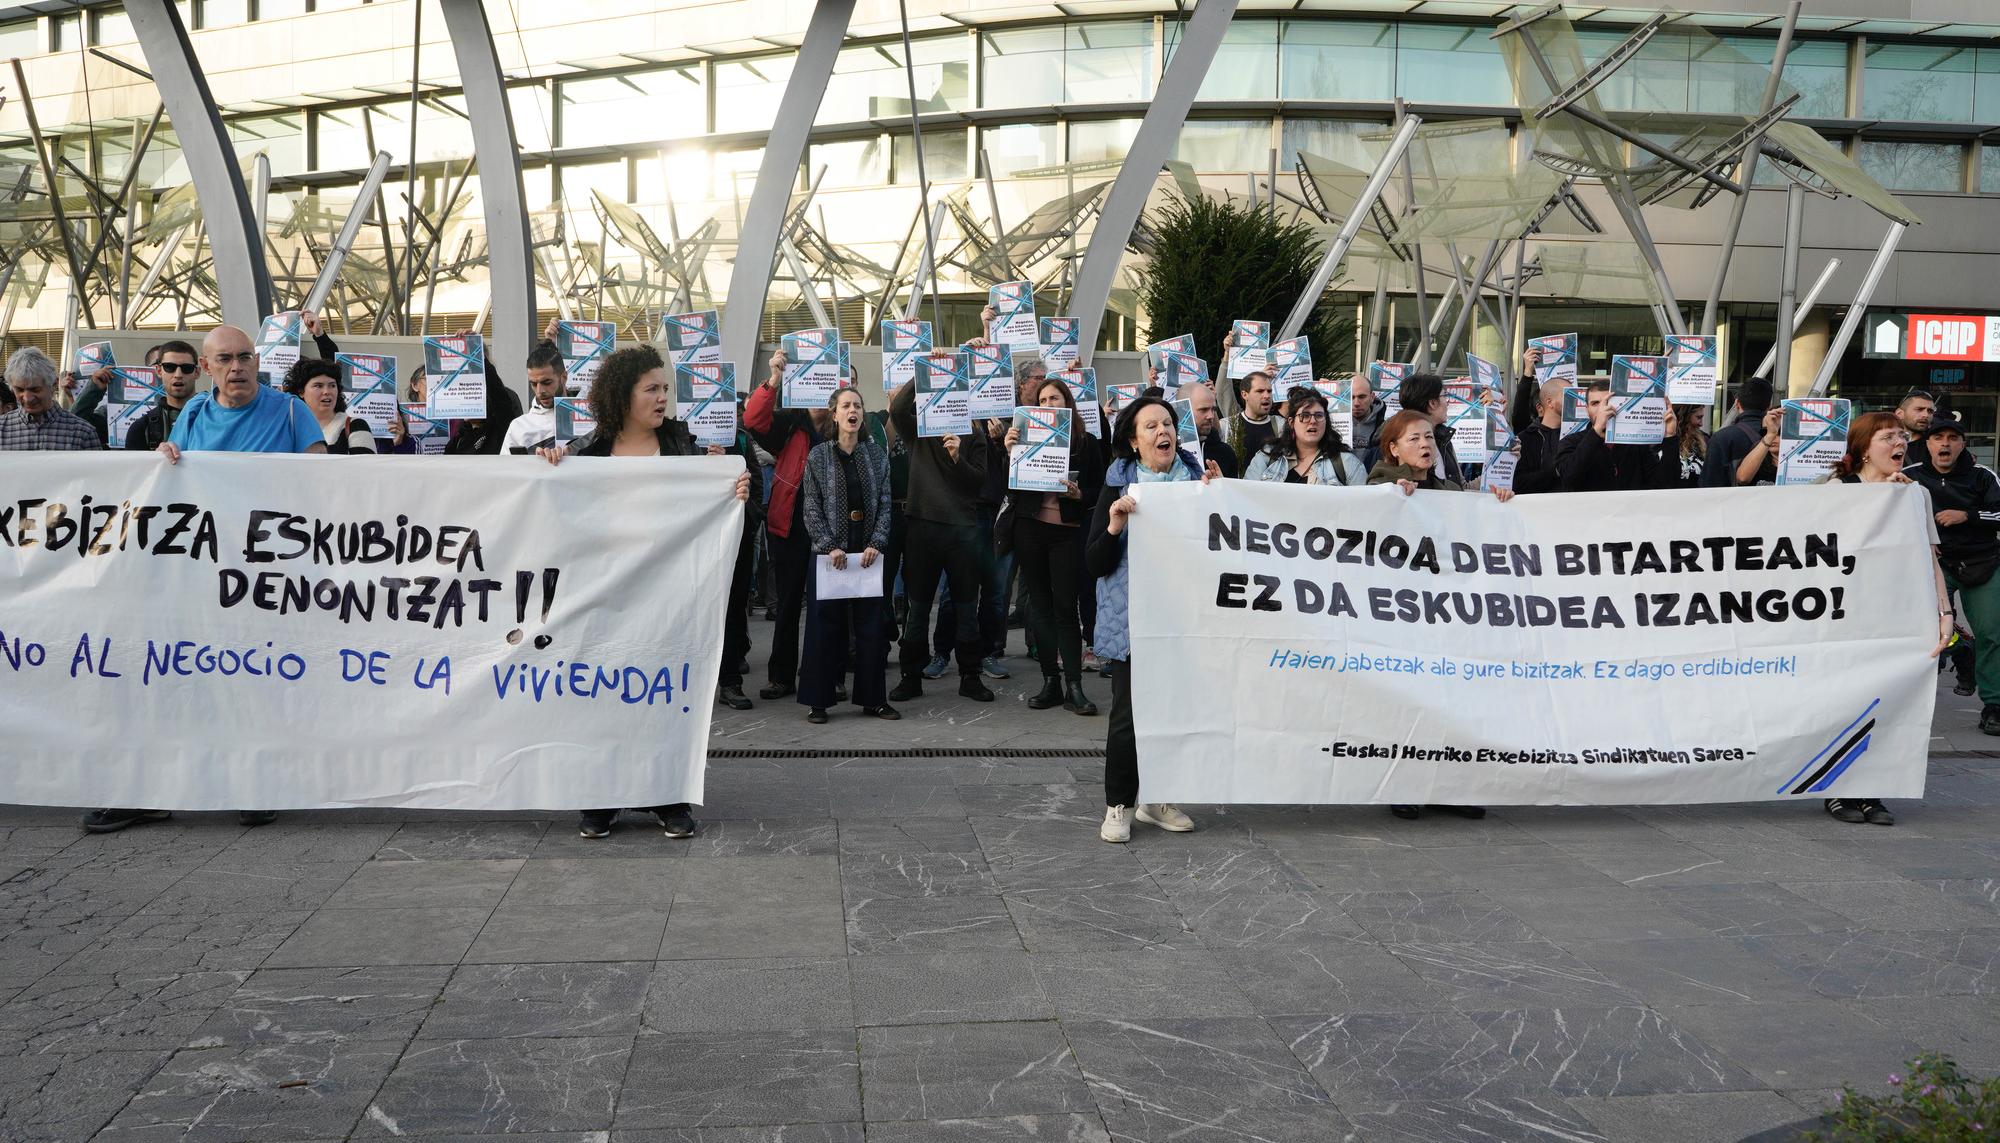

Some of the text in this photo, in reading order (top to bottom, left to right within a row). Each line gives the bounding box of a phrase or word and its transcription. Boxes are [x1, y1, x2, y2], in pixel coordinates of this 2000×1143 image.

[573, 325, 599, 342] ICHP
[680, 316, 704, 333] ICHP
[798, 332, 823, 347] ICHP
[1680, 338, 1703, 353] ICHP
[1915, 320, 1977, 355] ICHP
[440, 339, 466, 357] ICHP
[353, 358, 380, 376] ICHP
[693, 366, 719, 384] ICHP
[1630, 360, 1654, 378] ICHP
[1029, 410, 1055, 428] ICHP
[1801, 402, 1832, 421] ICHP
[1208, 513, 1856, 577] NEGOZIOA DEN BITARTEAN,
[1216, 573, 1845, 628] EZ DA ESKUBIDEA IZANGO!
[70, 632, 122, 678] AL
[339, 648, 391, 685] DE
[414, 656, 451, 696] LA
[1269, 649, 1797, 681] Haien jabetzak ala gure bizitzak. Ez dago erdibiderik!
[1401, 746, 1473, 762] Herriko
[1476, 748, 1579, 764] Etxebizitza
[1581, 747, 1691, 764] Sindikatuen
